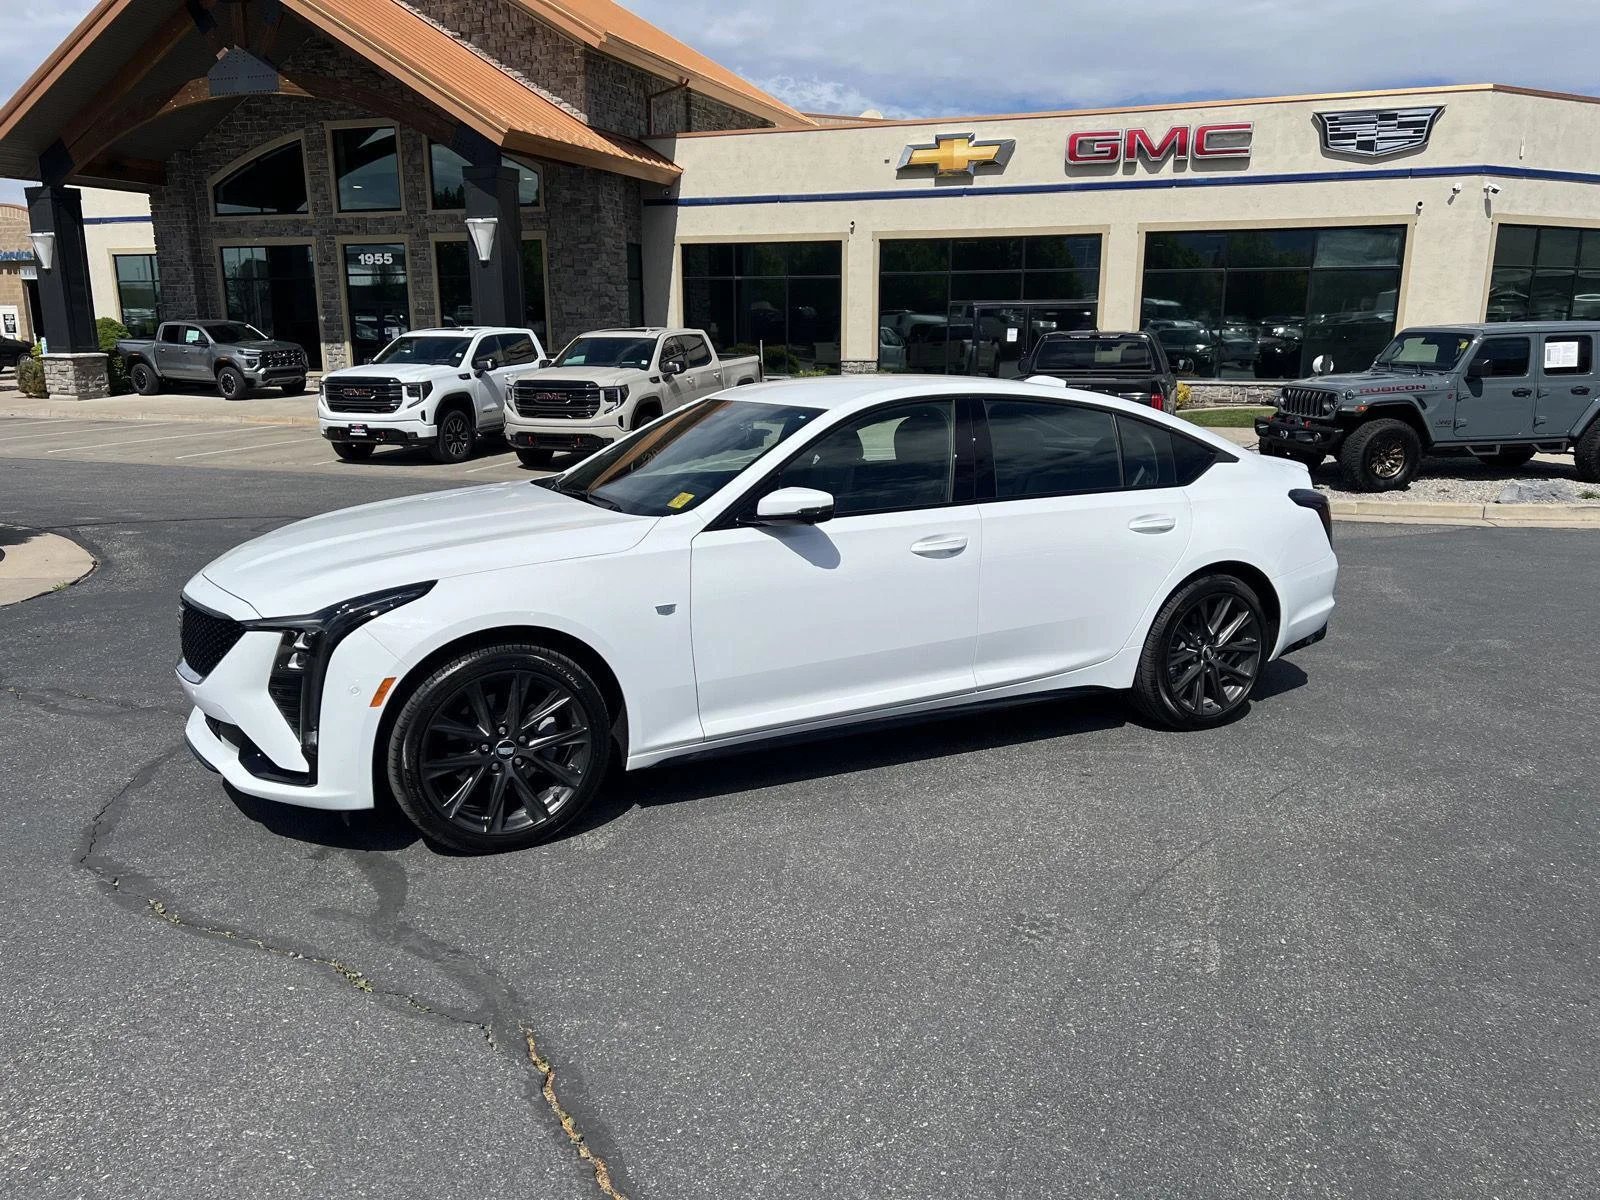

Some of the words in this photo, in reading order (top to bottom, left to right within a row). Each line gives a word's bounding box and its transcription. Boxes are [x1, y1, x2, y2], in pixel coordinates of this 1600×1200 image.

[1065, 121, 1254, 164] GMC
[358, 253, 393, 265] 1955
[1359, 384, 1426, 394] RUBICON
